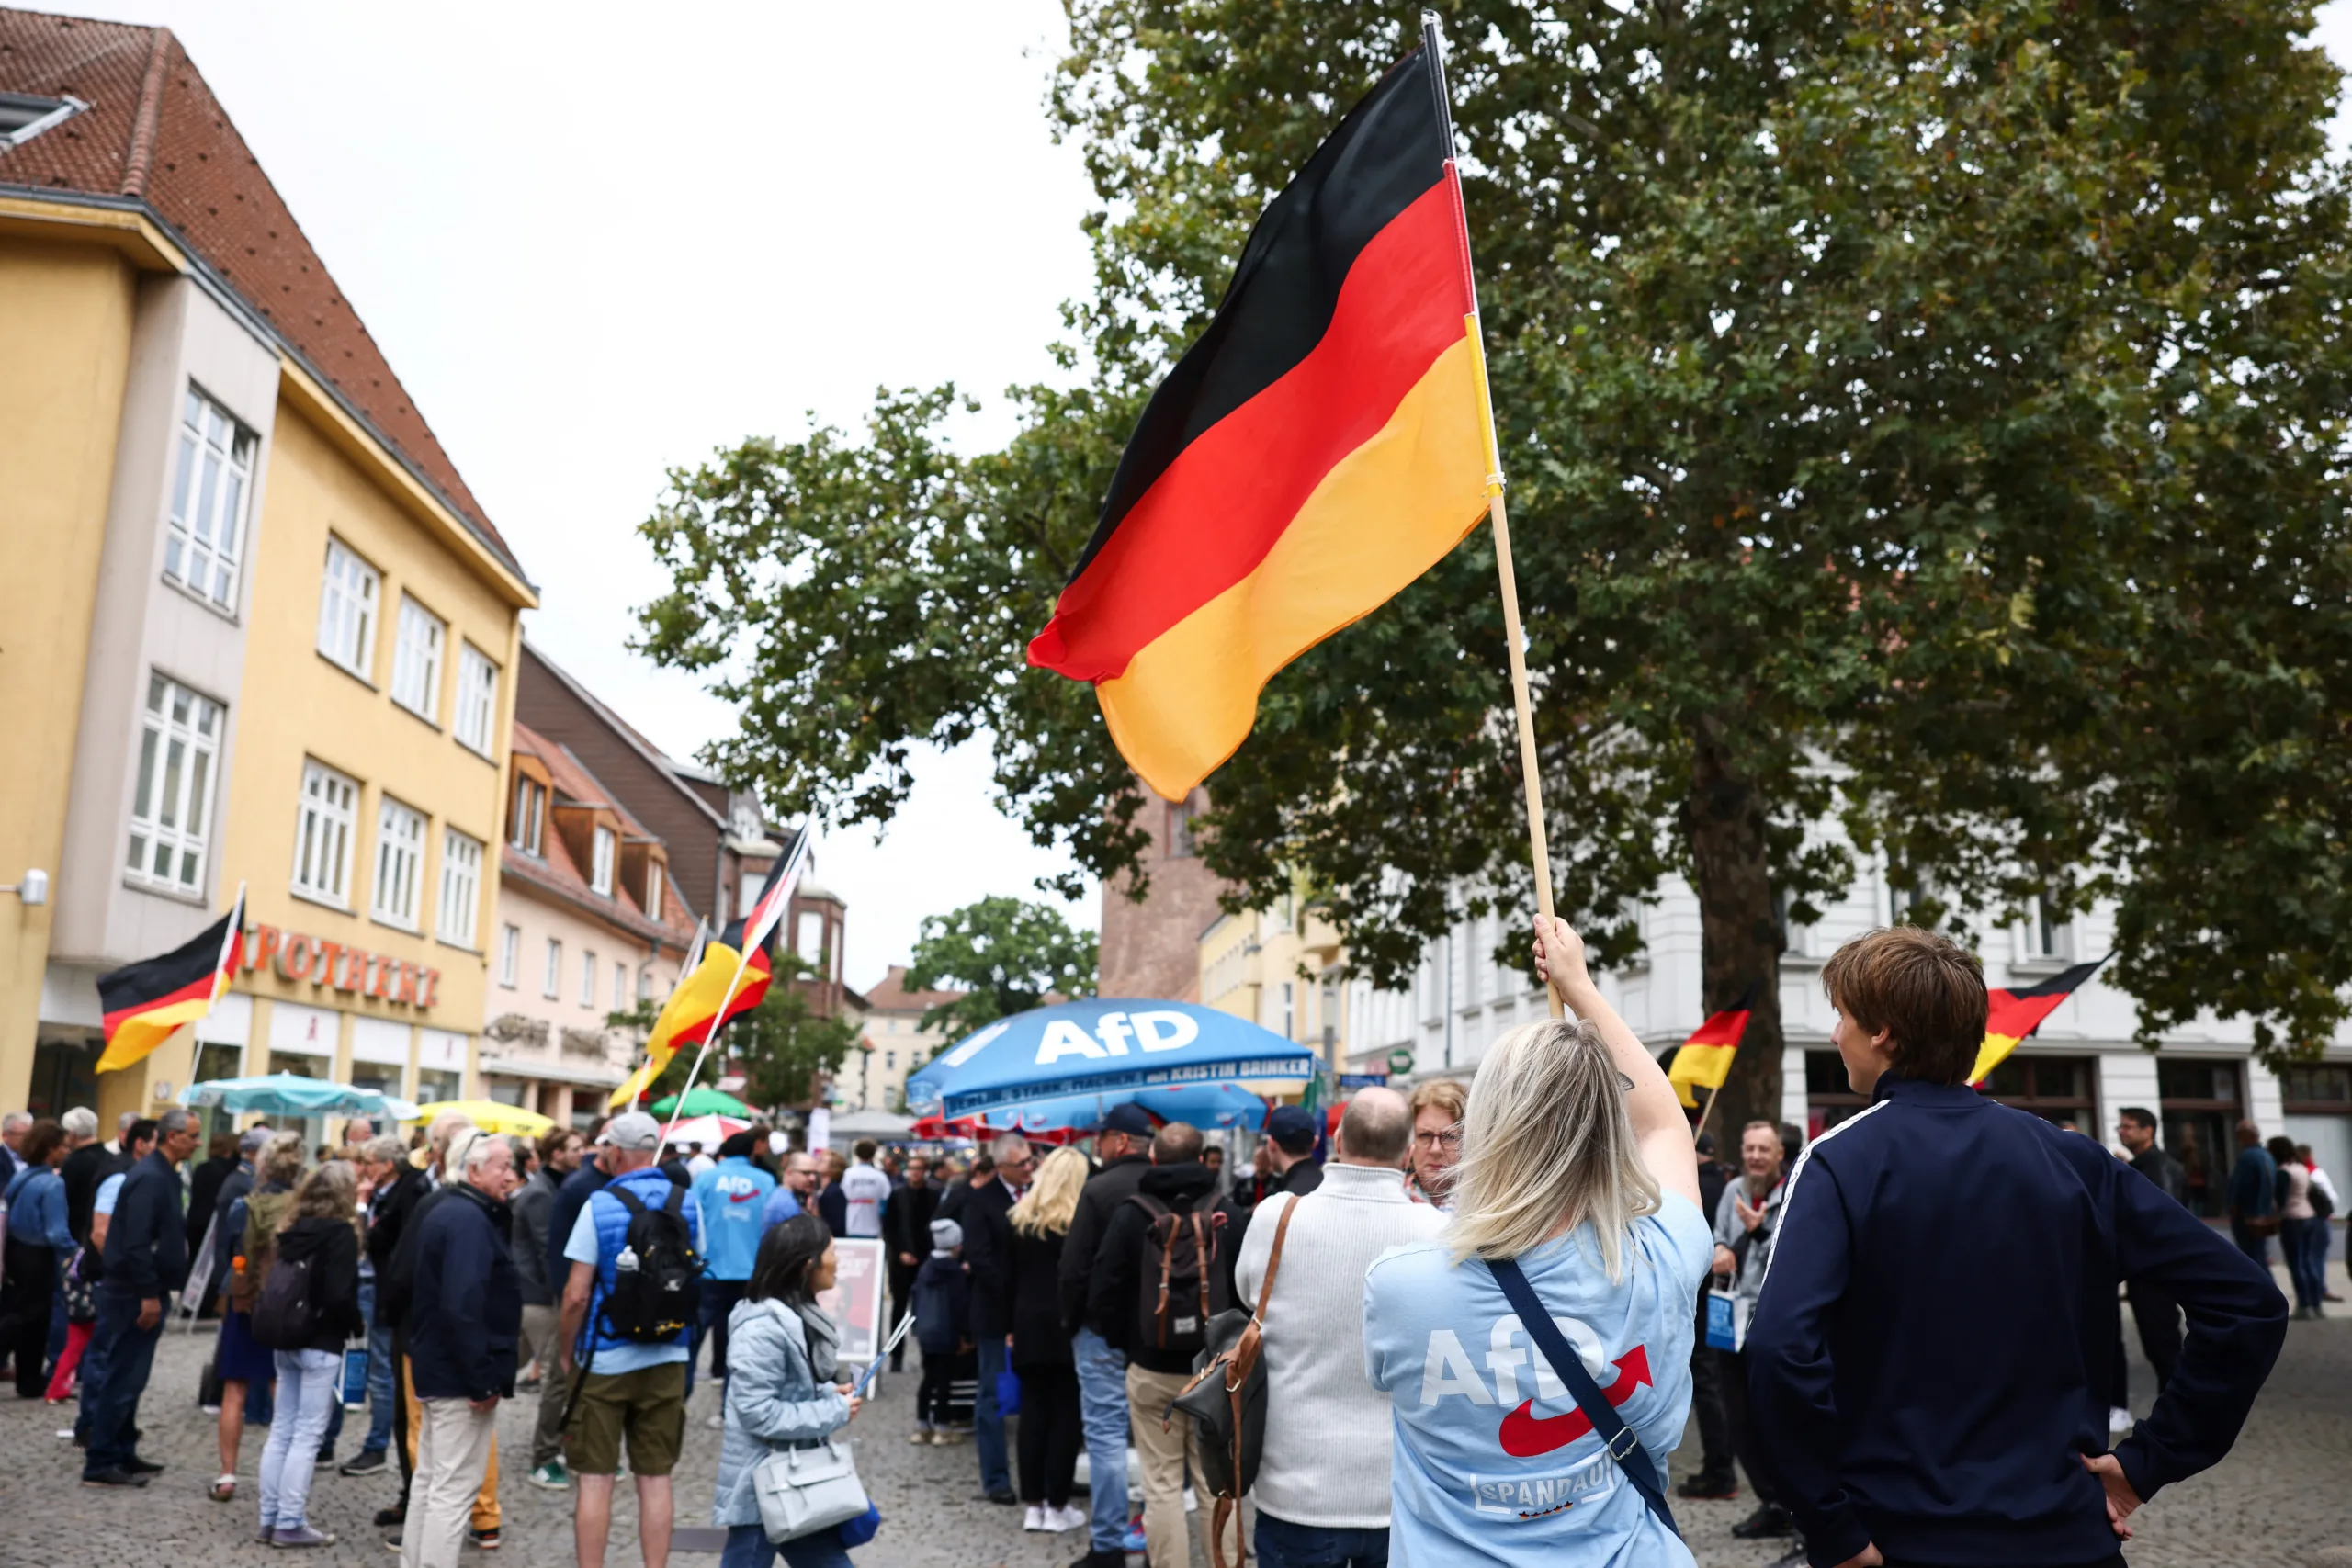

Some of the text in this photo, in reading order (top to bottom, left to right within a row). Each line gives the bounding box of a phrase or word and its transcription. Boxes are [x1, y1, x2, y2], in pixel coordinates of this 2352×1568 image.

[240, 922, 440, 1007] POTHEKE
[1035, 1010, 1199, 1064] AfD
[1170, 1061, 1237, 1082] KRISTIN
[1239, 1057, 1310, 1077] BRINKER
[715, 1174, 753, 1194] AfD
[1419, 1314, 1604, 1407] AfD
[1479, 1461, 1604, 1506] SPANDAU
